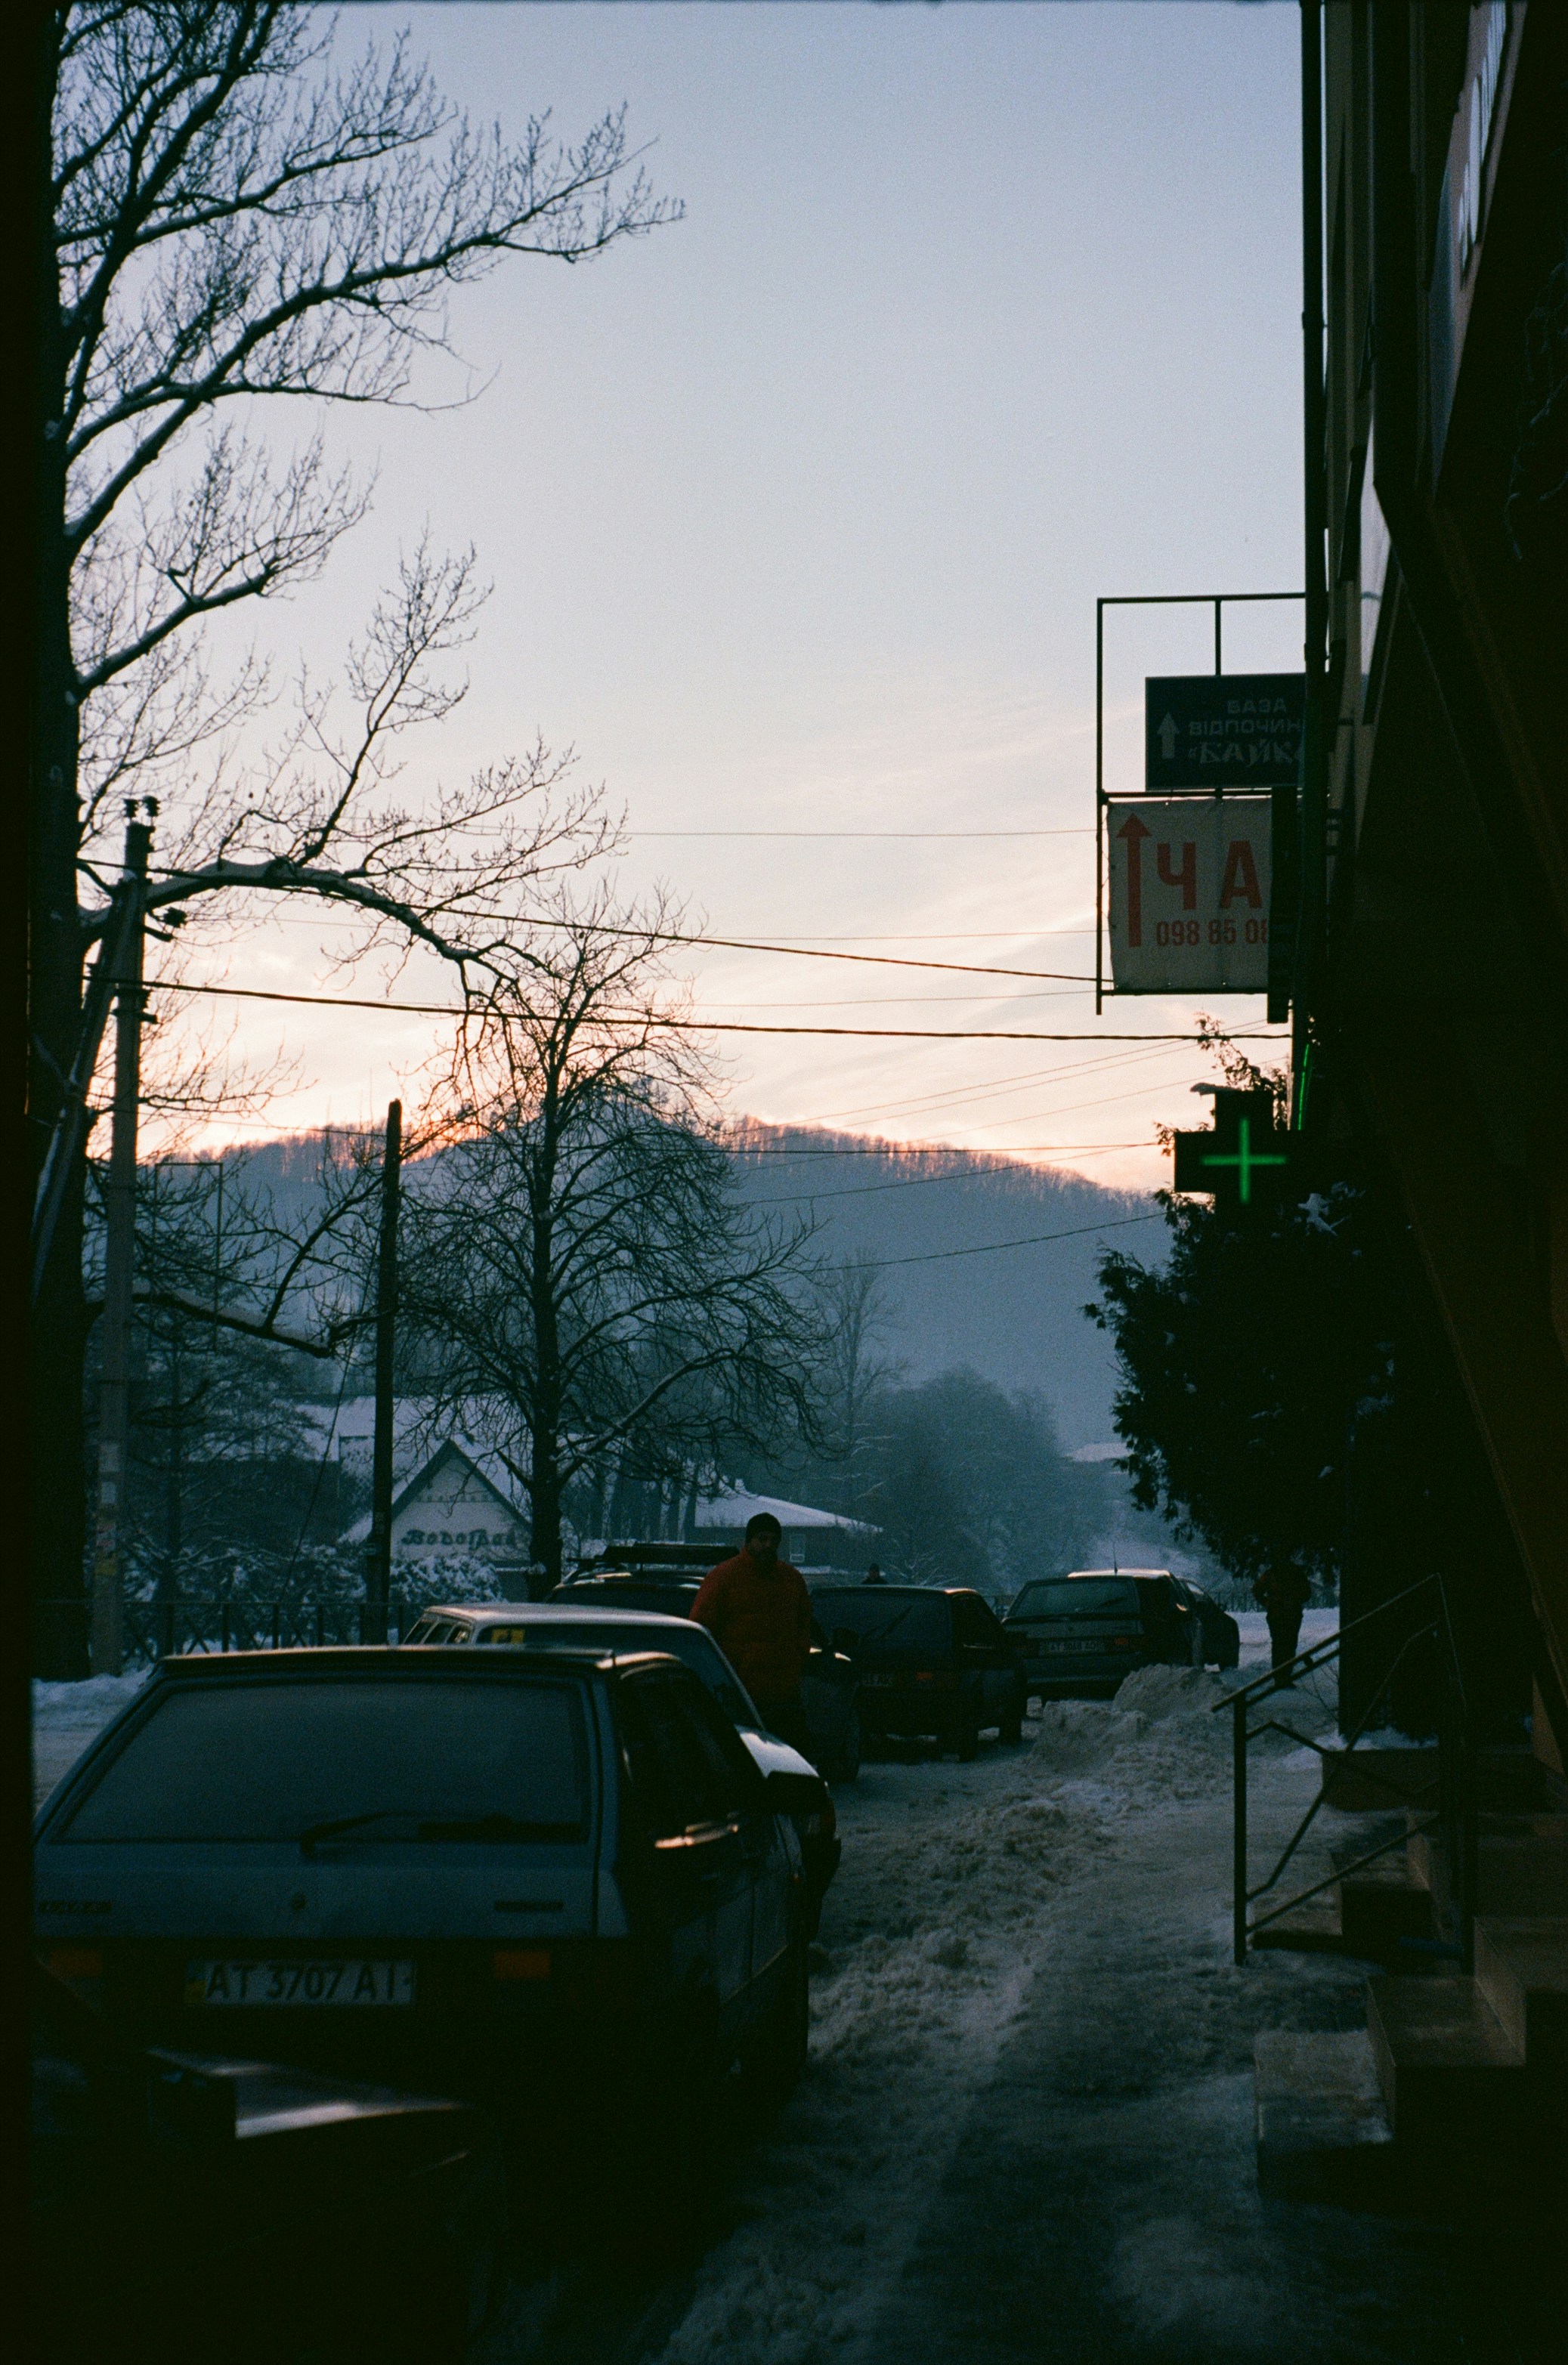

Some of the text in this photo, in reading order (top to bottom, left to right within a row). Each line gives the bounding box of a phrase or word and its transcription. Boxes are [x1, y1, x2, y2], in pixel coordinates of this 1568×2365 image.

[1226, 697, 1287, 714] БАЗА
[1156, 920, 1201, 946] 098
[206, 1965, 257, 1999] AT
[266, 1965, 345, 1999] 3707
